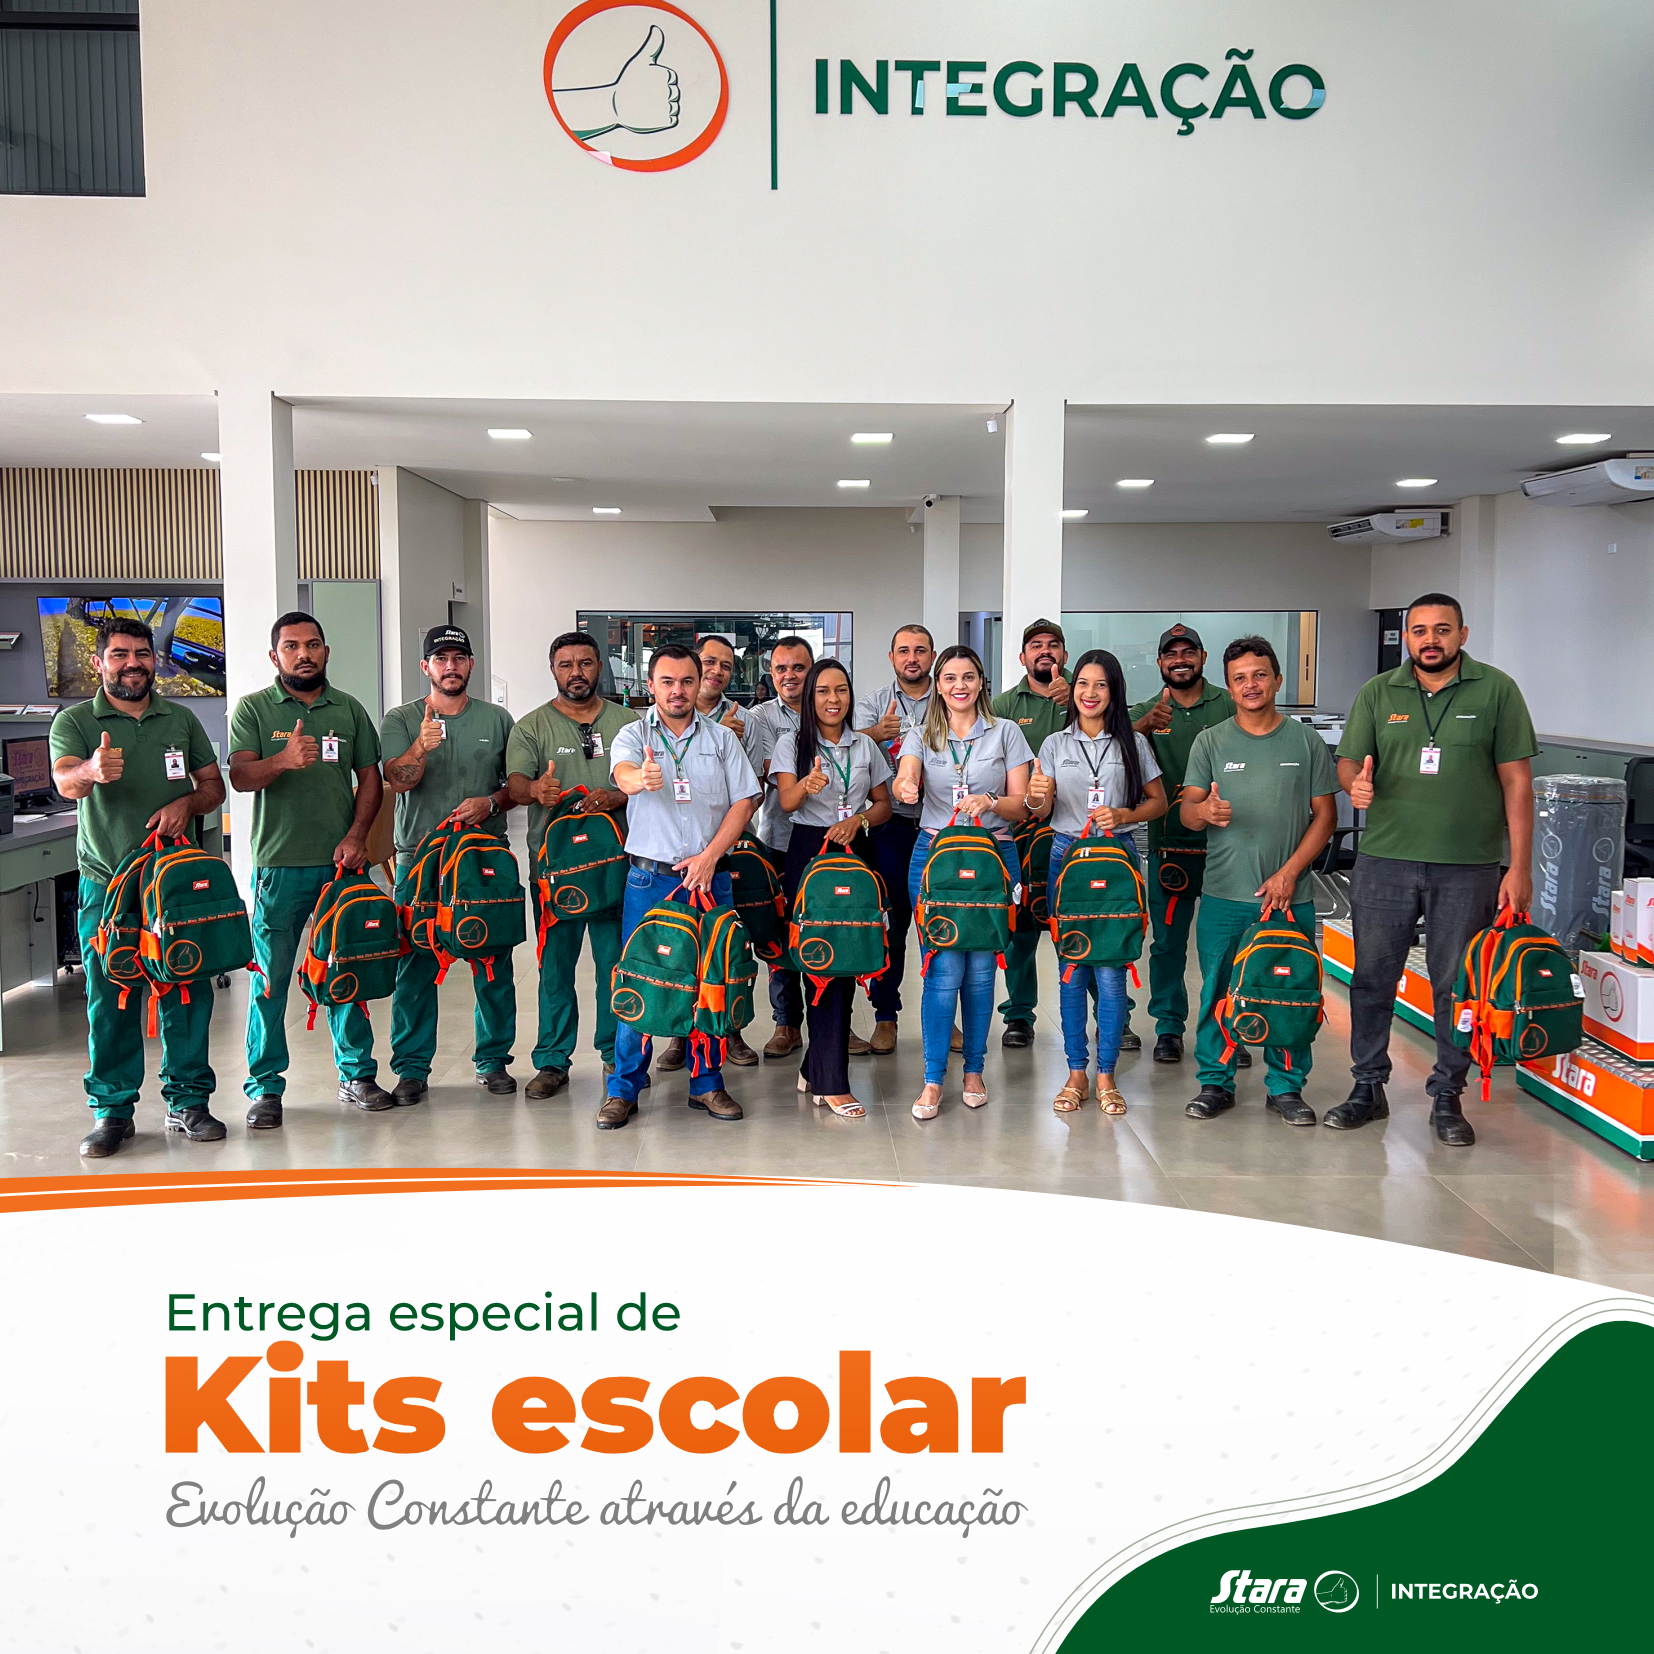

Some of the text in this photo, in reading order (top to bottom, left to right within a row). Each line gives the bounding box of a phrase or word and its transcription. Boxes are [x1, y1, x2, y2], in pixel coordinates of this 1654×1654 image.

[816, 48, 1326, 137] INTEGRAÇÃO
[1387, 713, 1410, 722] Stara
[556, 746, 576, 755] Stara
[1224, 762, 1246, 770] Stara
[1540, 861, 1559, 916] Stara
[1592, 865, 1612, 918] Stara
[1580, 960, 1598, 981] Stara
[1552, 1053, 1598, 1098] Stara
